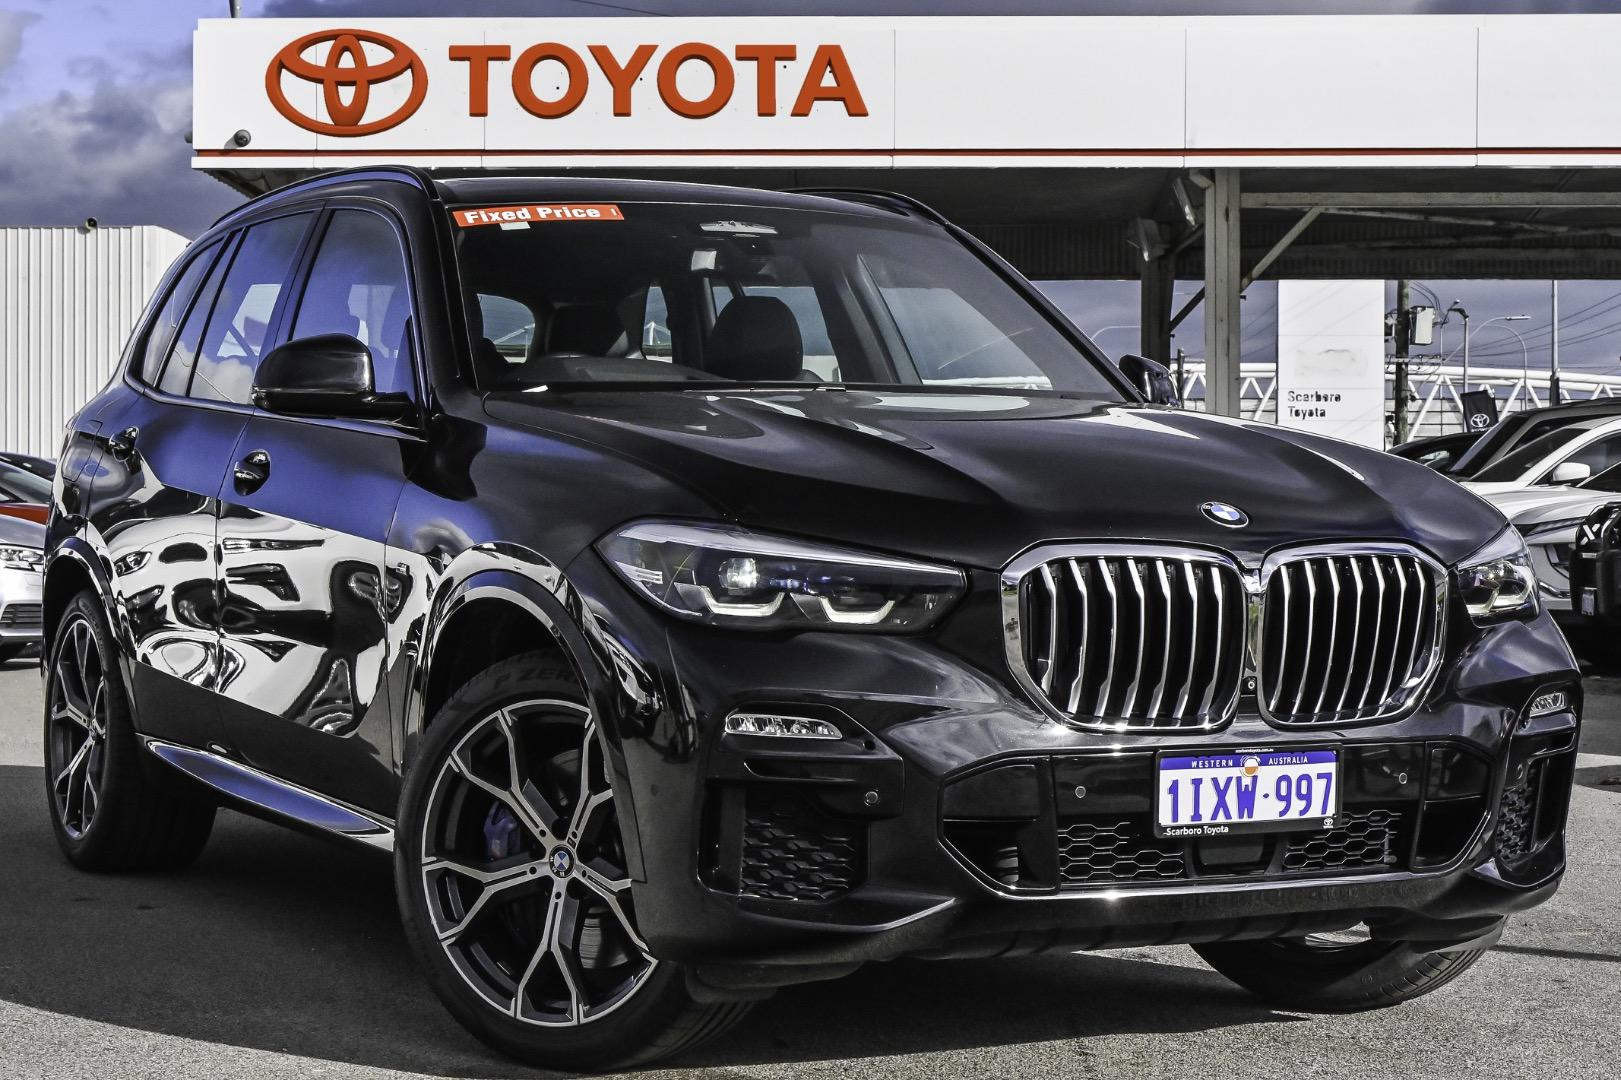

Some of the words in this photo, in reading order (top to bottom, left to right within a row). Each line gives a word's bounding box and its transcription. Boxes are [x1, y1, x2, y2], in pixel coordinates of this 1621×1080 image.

[448, 42, 869, 119] TOYOTA
[463, 208, 531, 224] Fixed
[536, 206, 601, 219] Price
[1287, 406, 1326, 420] Toyota
[1191, 759, 1233, 768] WESTERN
[1268, 756, 1308, 765] AUSTRALIA
[1166, 827, 1202, 836] Scarboro
[1203, 826, 1229, 835] Toyota
